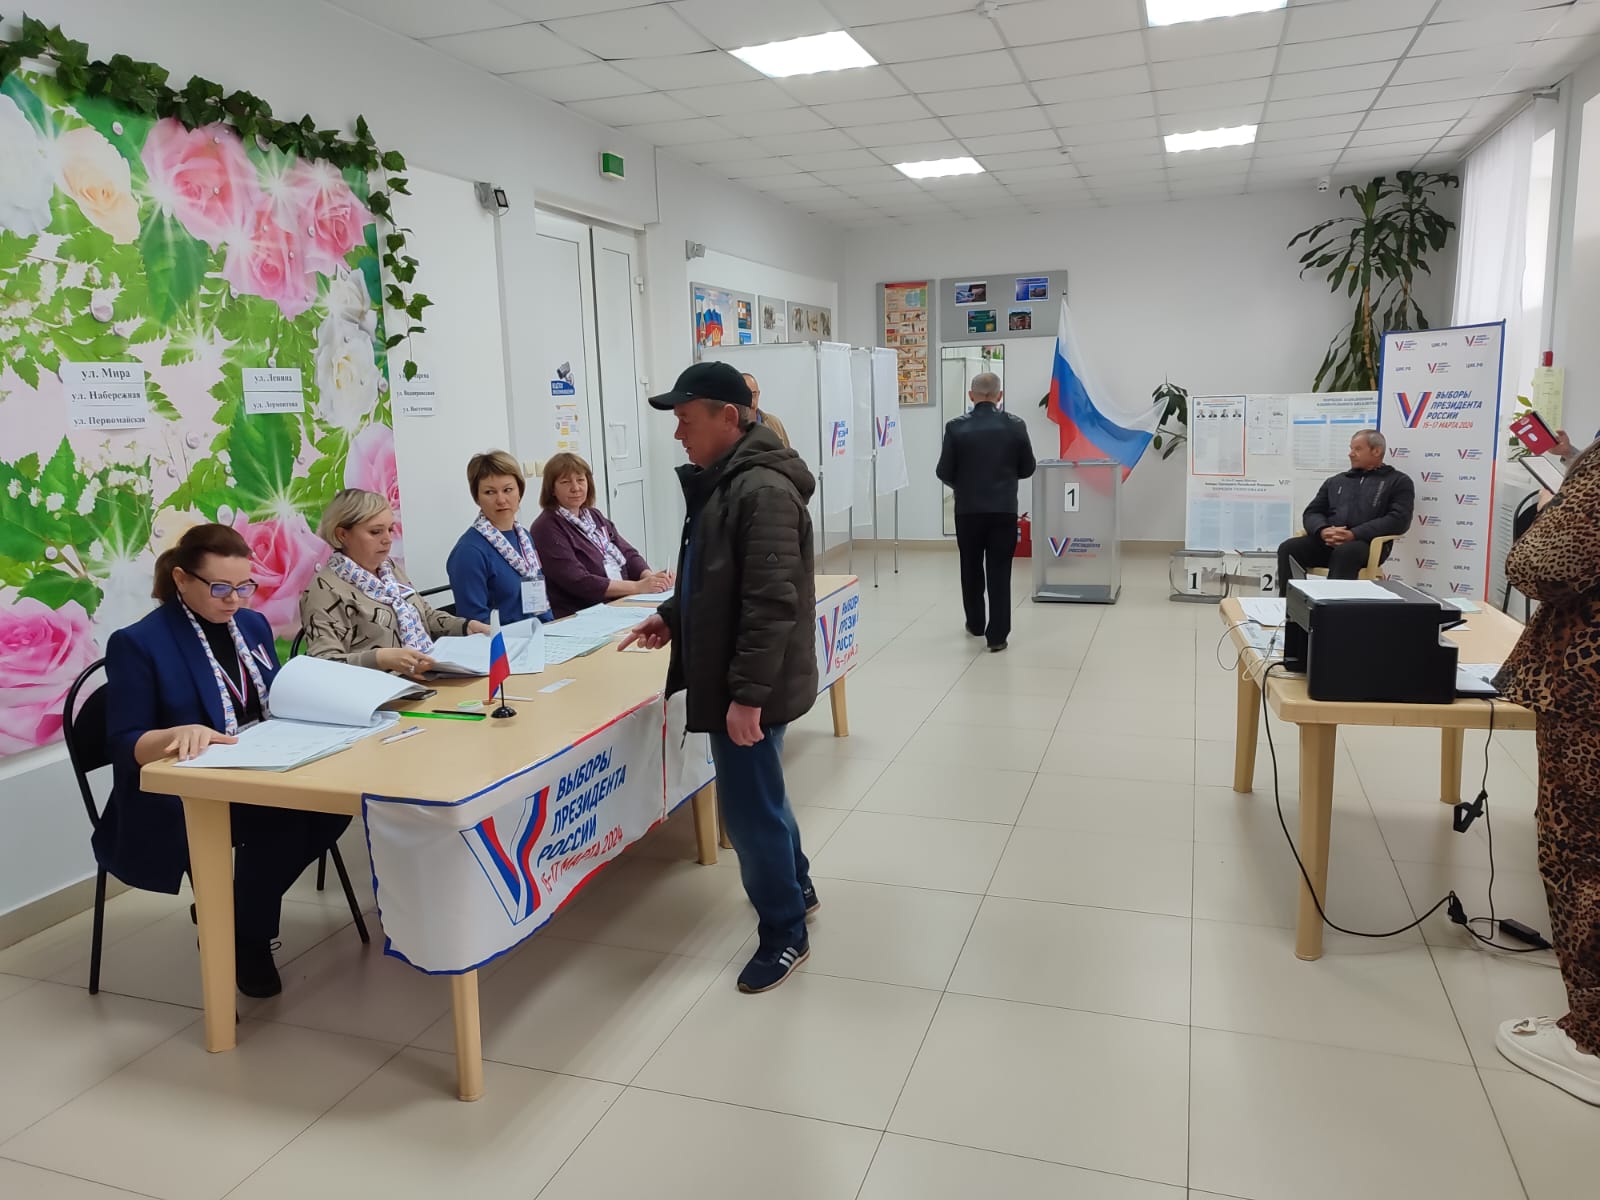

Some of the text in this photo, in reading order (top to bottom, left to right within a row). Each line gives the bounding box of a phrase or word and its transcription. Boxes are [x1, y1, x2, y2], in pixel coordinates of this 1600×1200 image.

[81, 368, 131, 381] ул. Мира
[71, 391, 141, 402] ул. Набережная
[1435, 391, 1472, 399] ВЫБОРЫ
[1431, 401, 1483, 409] ПРЕЗИДЕНТА
[73, 417, 146, 427] ул. Первомайская
[1426, 411, 1459, 419] РОССИИ
[1067, 488, 1075, 507] 1
[1191, 572, 1198, 589] 1
[1262, 574, 1273, 591] 2
[556, 747, 612, 802] ВЫБОРЫ
[551, 765, 626, 836] ПРЕЗИДЕНТА
[537, 814, 597, 868] РОССИИ
[601, 824, 623, 855] 2024
